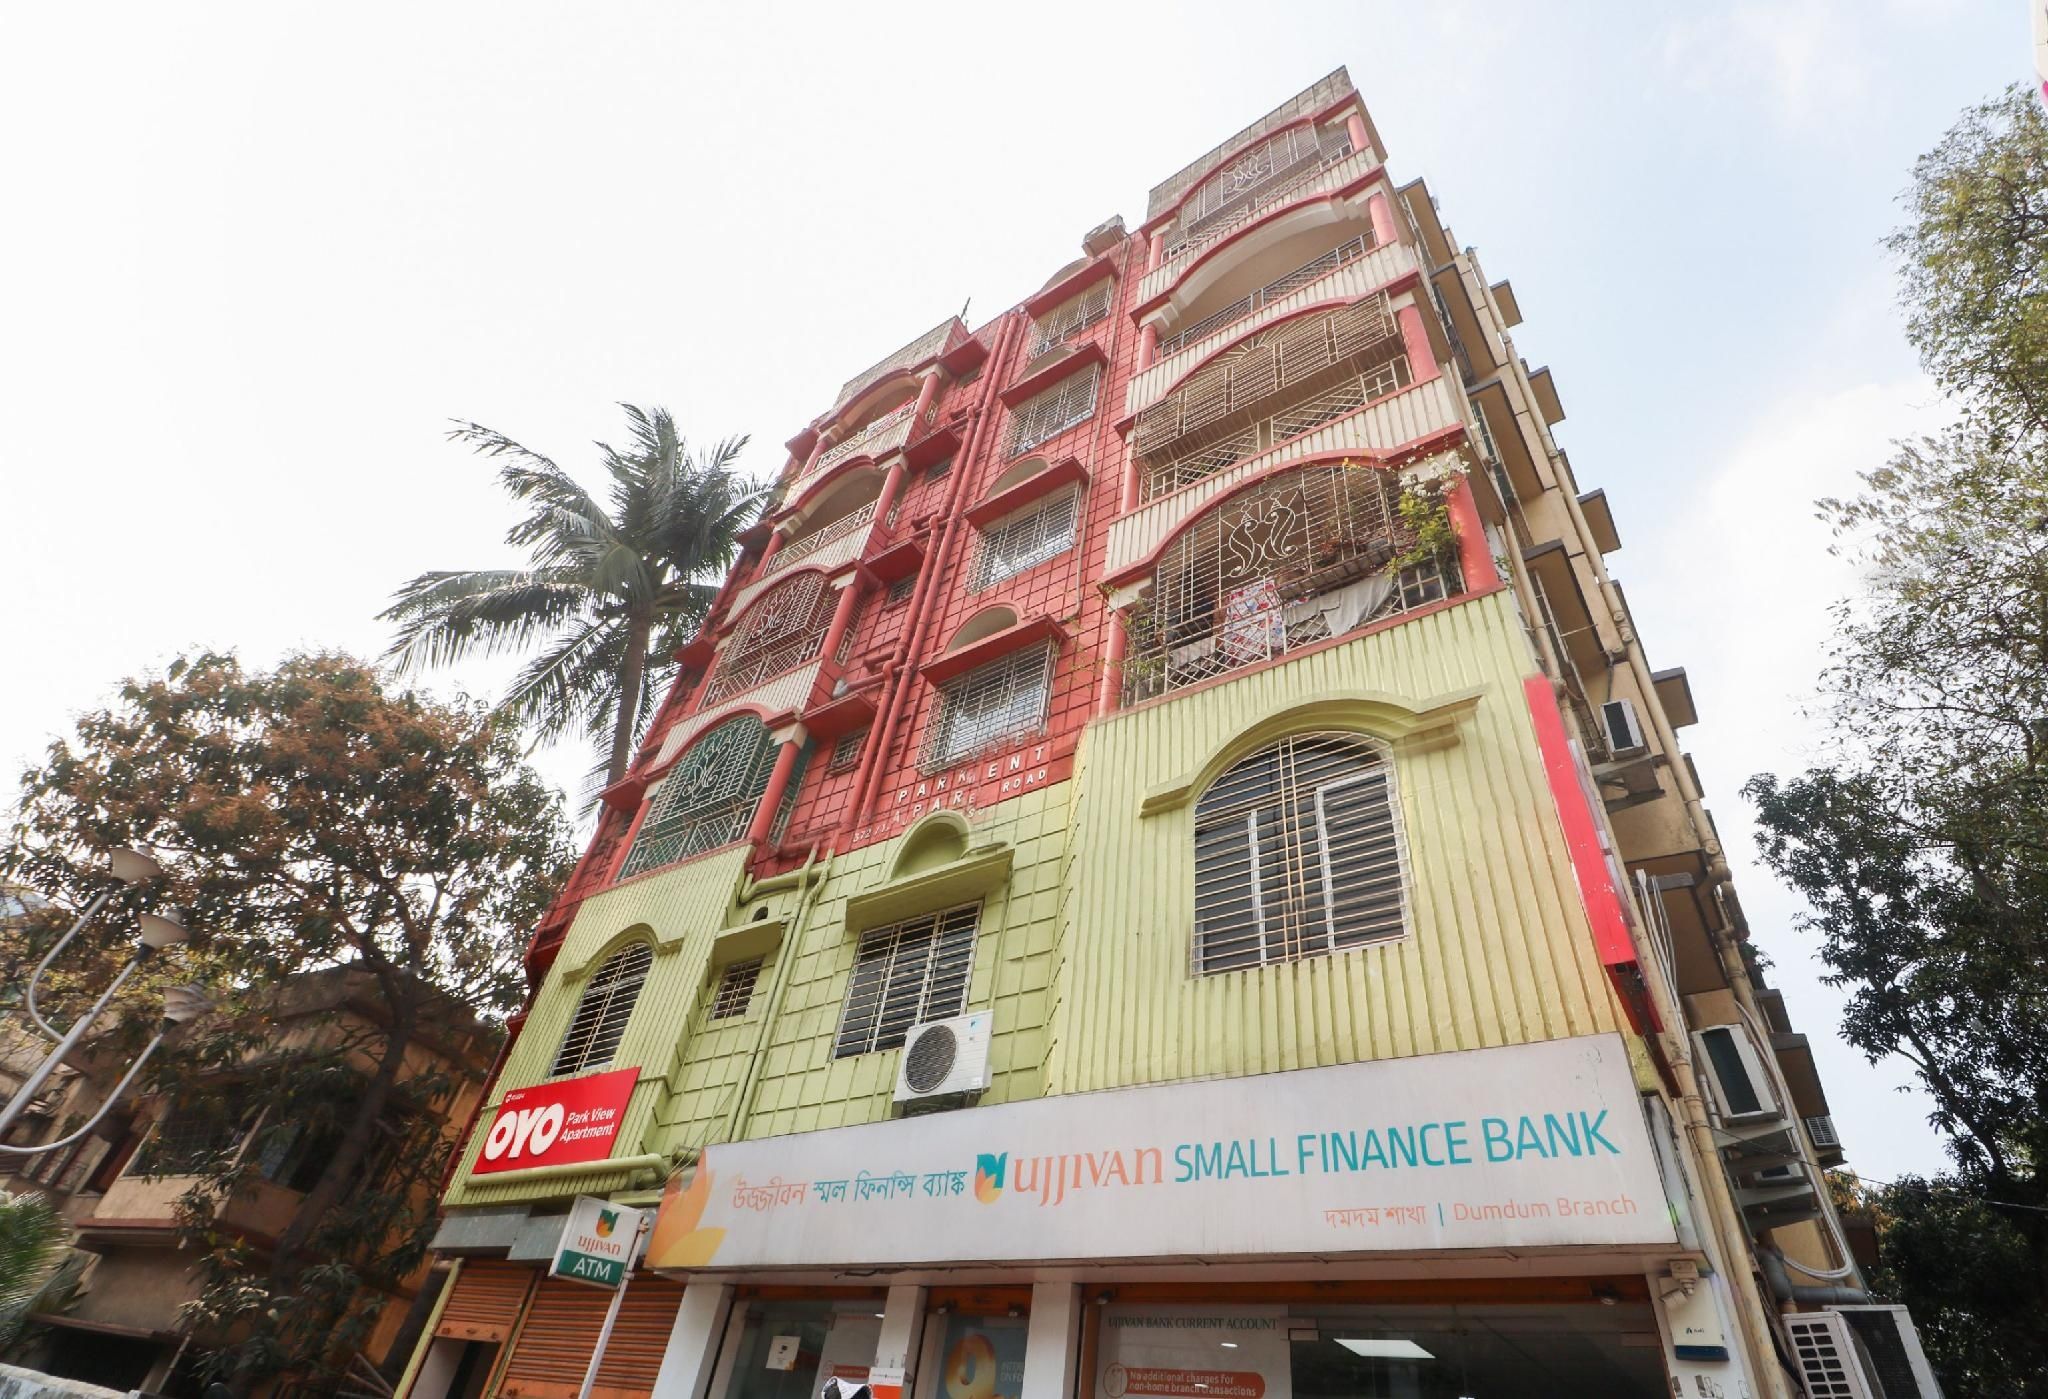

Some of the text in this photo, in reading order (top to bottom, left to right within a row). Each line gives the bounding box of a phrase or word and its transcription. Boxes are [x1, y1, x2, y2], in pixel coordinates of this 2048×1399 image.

[1003, 768, 1047, 793] ROAD
[566, 1108, 616, 1125] Park View
[485, 1103, 565, 1160] OYO
[560, 1123, 615, 1143] Apartment
[1174, 1137, 1290, 1183] SMALL
[1297, 1121, 1472, 1175] FINANCE
[1482, 1109, 1621, 1164] BANK
[1324, 1205, 1427, 1230] দমদম শাখা
[1453, 1194, 1638, 1222] Dumdum Branch
[572, 1257, 612, 1280] ATM
[1146, 1316, 1172, 1329] BANK
[1176, 1317, 1224, 1329] CURRENT
[1226, 1317, 1278, 1330] ACCOUNT
[1130, 1371, 1234, 1384] No additional charges for
[1130, 1382, 1257, 1397] non-home branch transactions
